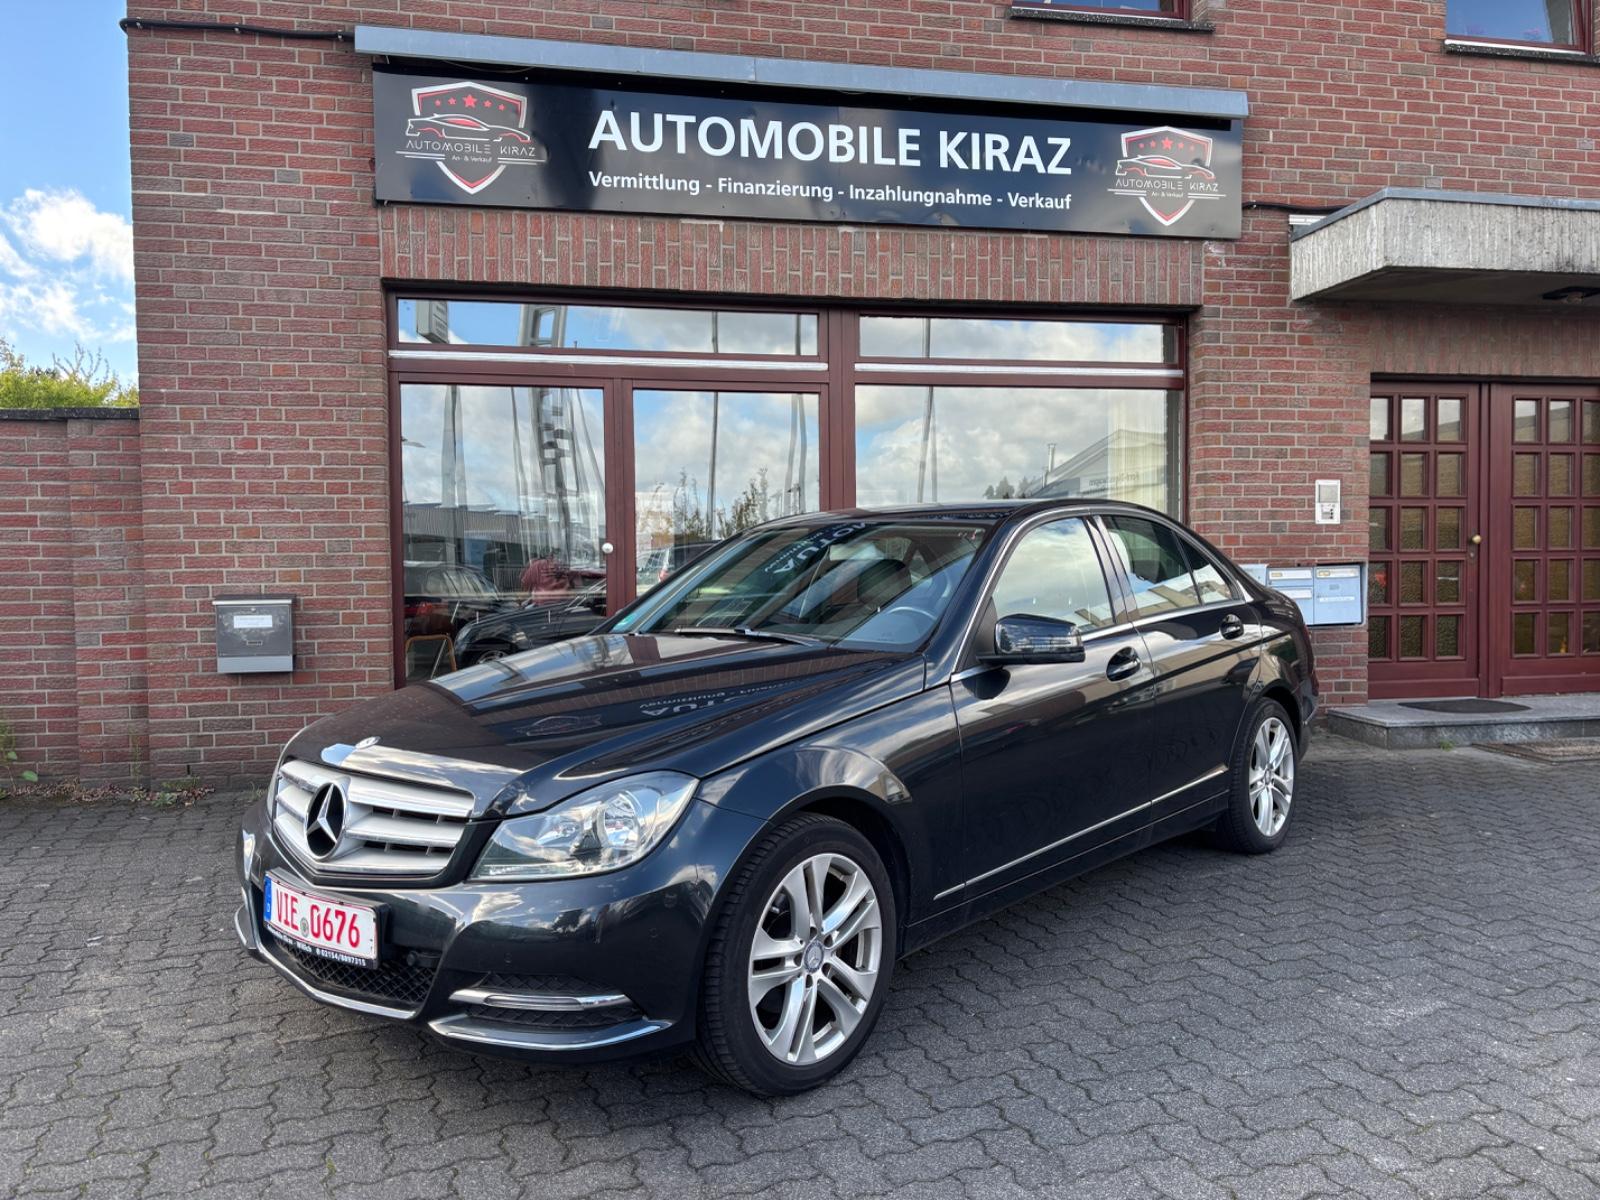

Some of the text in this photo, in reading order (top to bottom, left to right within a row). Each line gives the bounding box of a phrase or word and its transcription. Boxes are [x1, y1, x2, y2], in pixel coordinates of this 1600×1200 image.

[405, 140, 536, 157] AUTOMOBILE KIRAZ
[588, 110, 1072, 175] AUTOMOBILE KIRAZ
[588, 171, 700, 196] Vermittlung
[718, 177, 833, 202] Finanzierung
[849, 184, 992, 207] Inzahlungnahme
[1008, 192, 1072, 209] Verkauf
[1115, 178, 1219, 193] AUTOMOBILE KIRAZ
[276, 888, 299, 931] VIE
[310, 904, 360, 949] 0676
